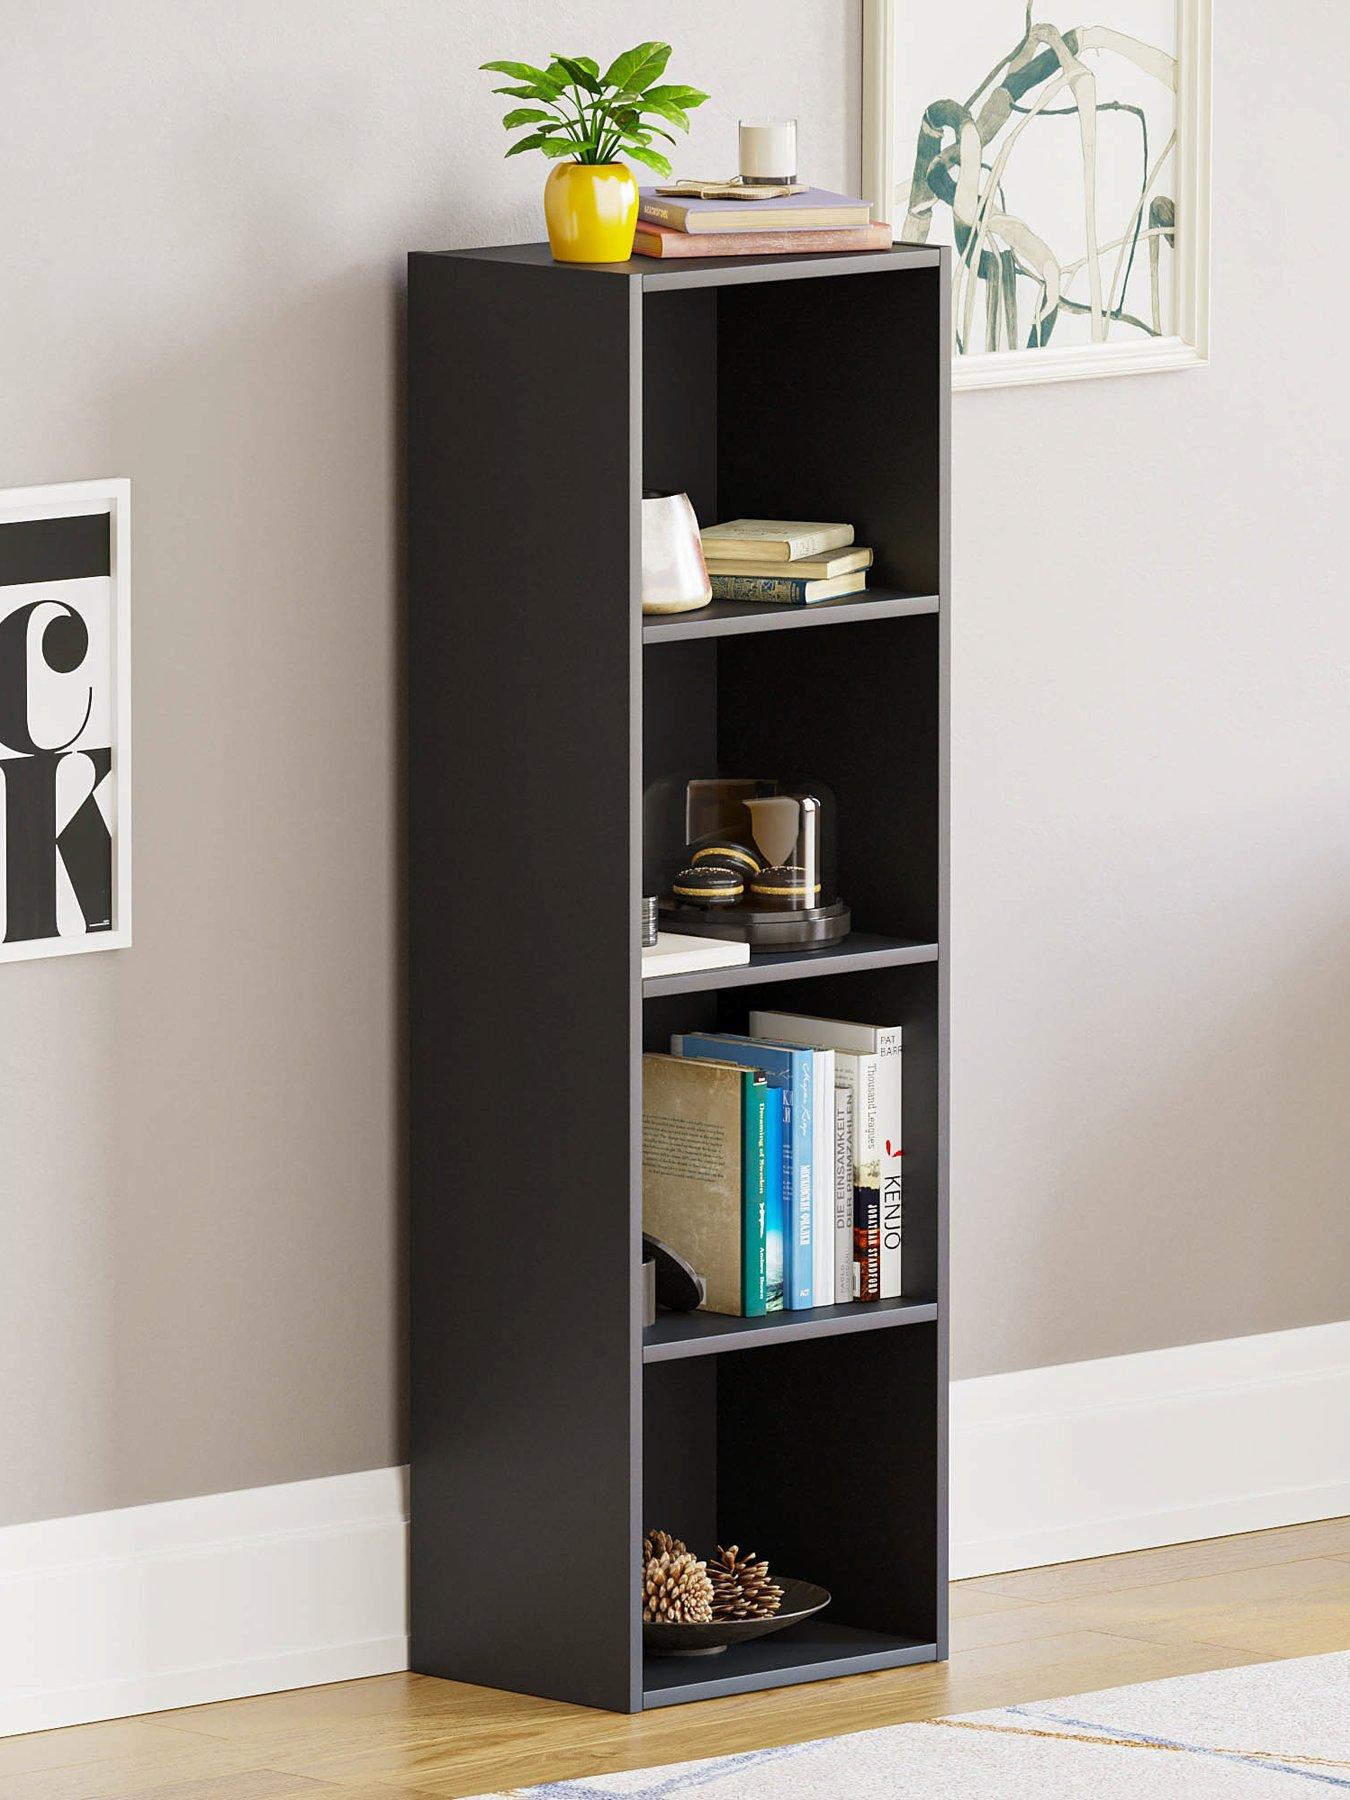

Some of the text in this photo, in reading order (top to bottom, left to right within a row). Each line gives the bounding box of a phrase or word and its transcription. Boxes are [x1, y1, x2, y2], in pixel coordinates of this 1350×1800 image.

[880, 1035, 896, 1045] PAT
[867, 1062, 877, 1110] Thousand
[836, 1109, 846, 1229] DIE EINSAMKEIT
[884, 1175, 901, 1250] KENJO
